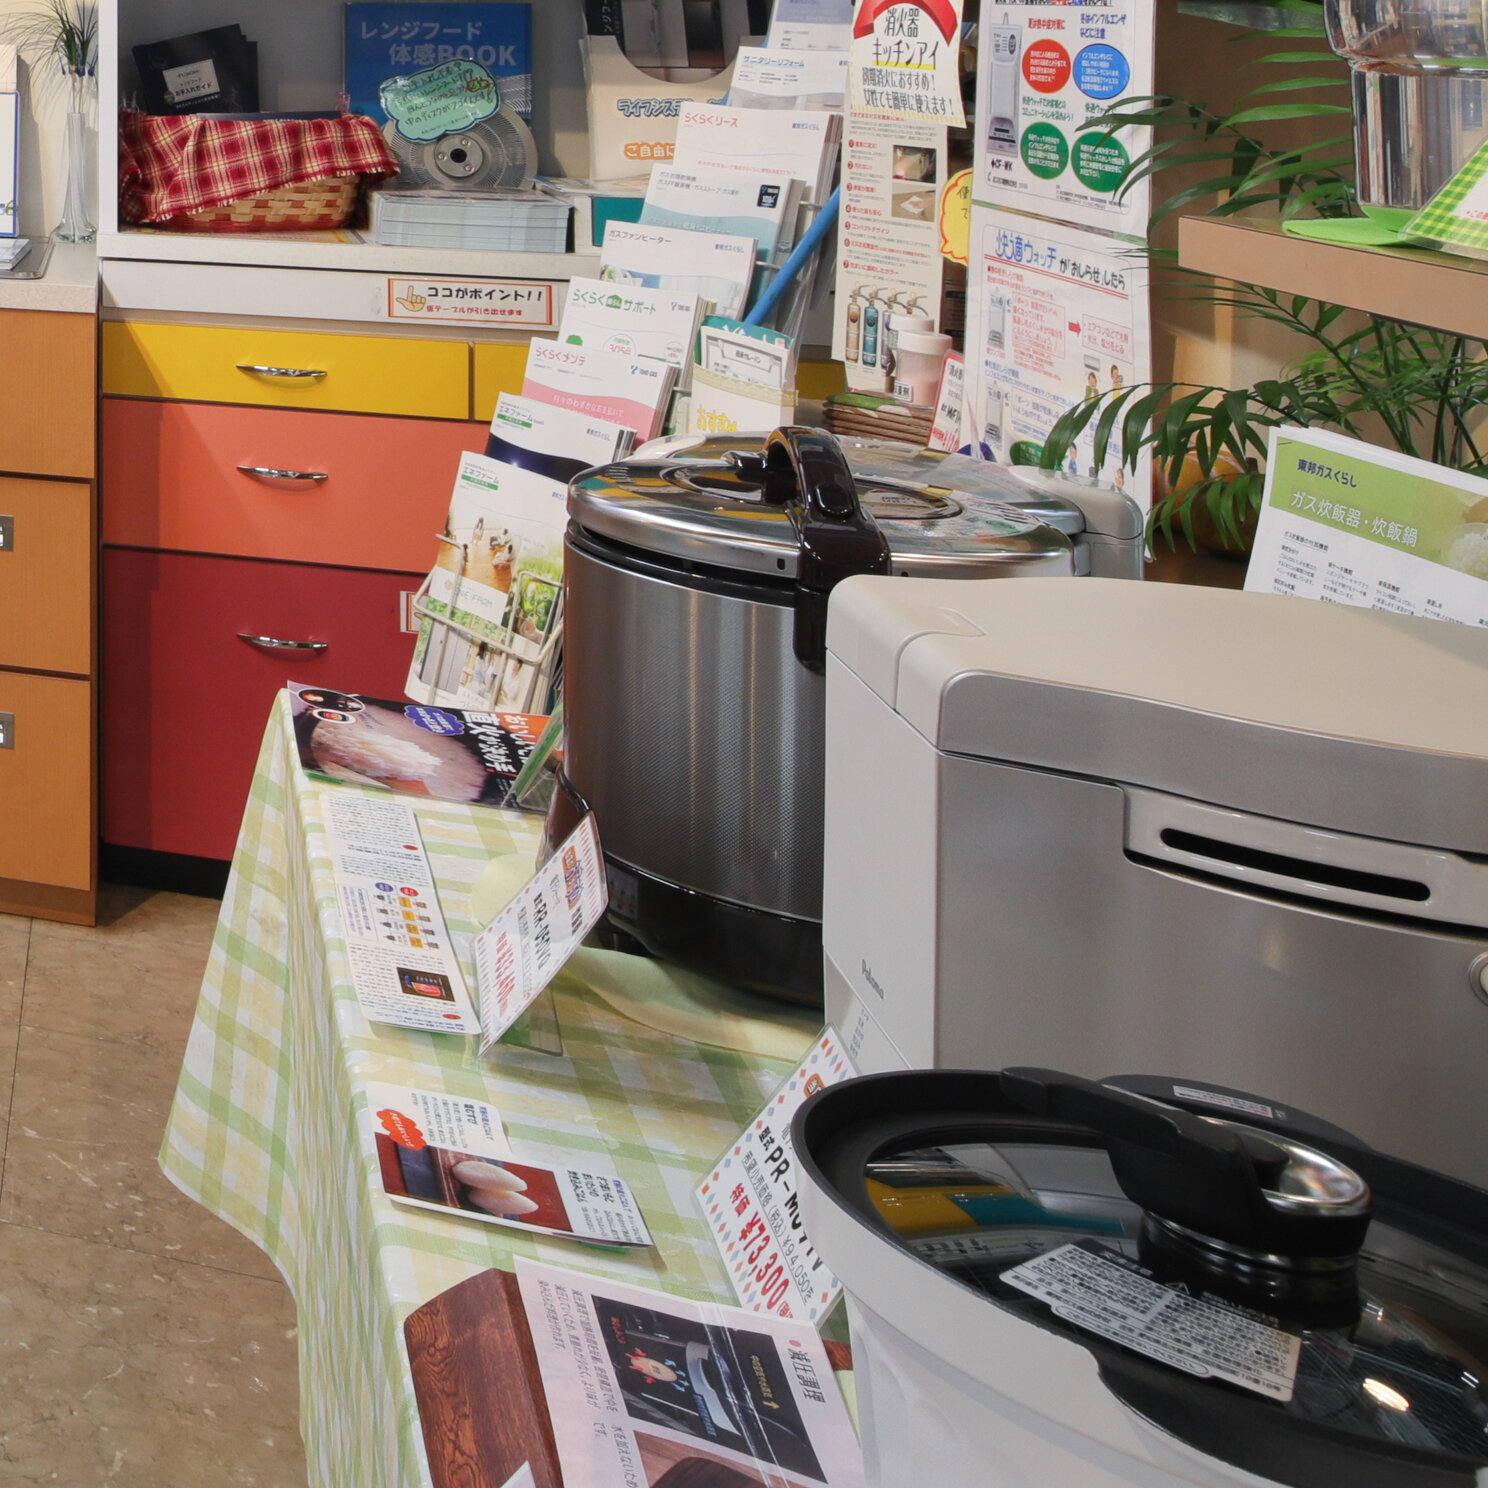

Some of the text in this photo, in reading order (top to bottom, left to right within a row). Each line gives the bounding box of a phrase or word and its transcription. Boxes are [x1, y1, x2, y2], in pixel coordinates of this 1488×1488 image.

[360, 22, 481, 40] レンジフード
[886, 8, 919, 37] 消火器
[872, 37, 938, 70] キッチンアイ
[862, 68, 936, 92] 初期消火におすすめ!
[863, 88, 955, 117] 女性でも簡単に使えます!
[684, 113, 739, 128] らくらくリース
[609, 229, 673, 245] ガスファンヒーター
[995, 229, 1057, 269] 快適ウォッチ
[426, 286, 544, 302] ココがポイント!!
[535, 347, 586, 366] らくらくメンテ
[1297, 458, 1357, 488] 東邦ガスくらし
[1290, 491, 1419, 548] ガス炊飯器・炊飯鍋
[787, 1347, 826, 1404] 減圧調理
